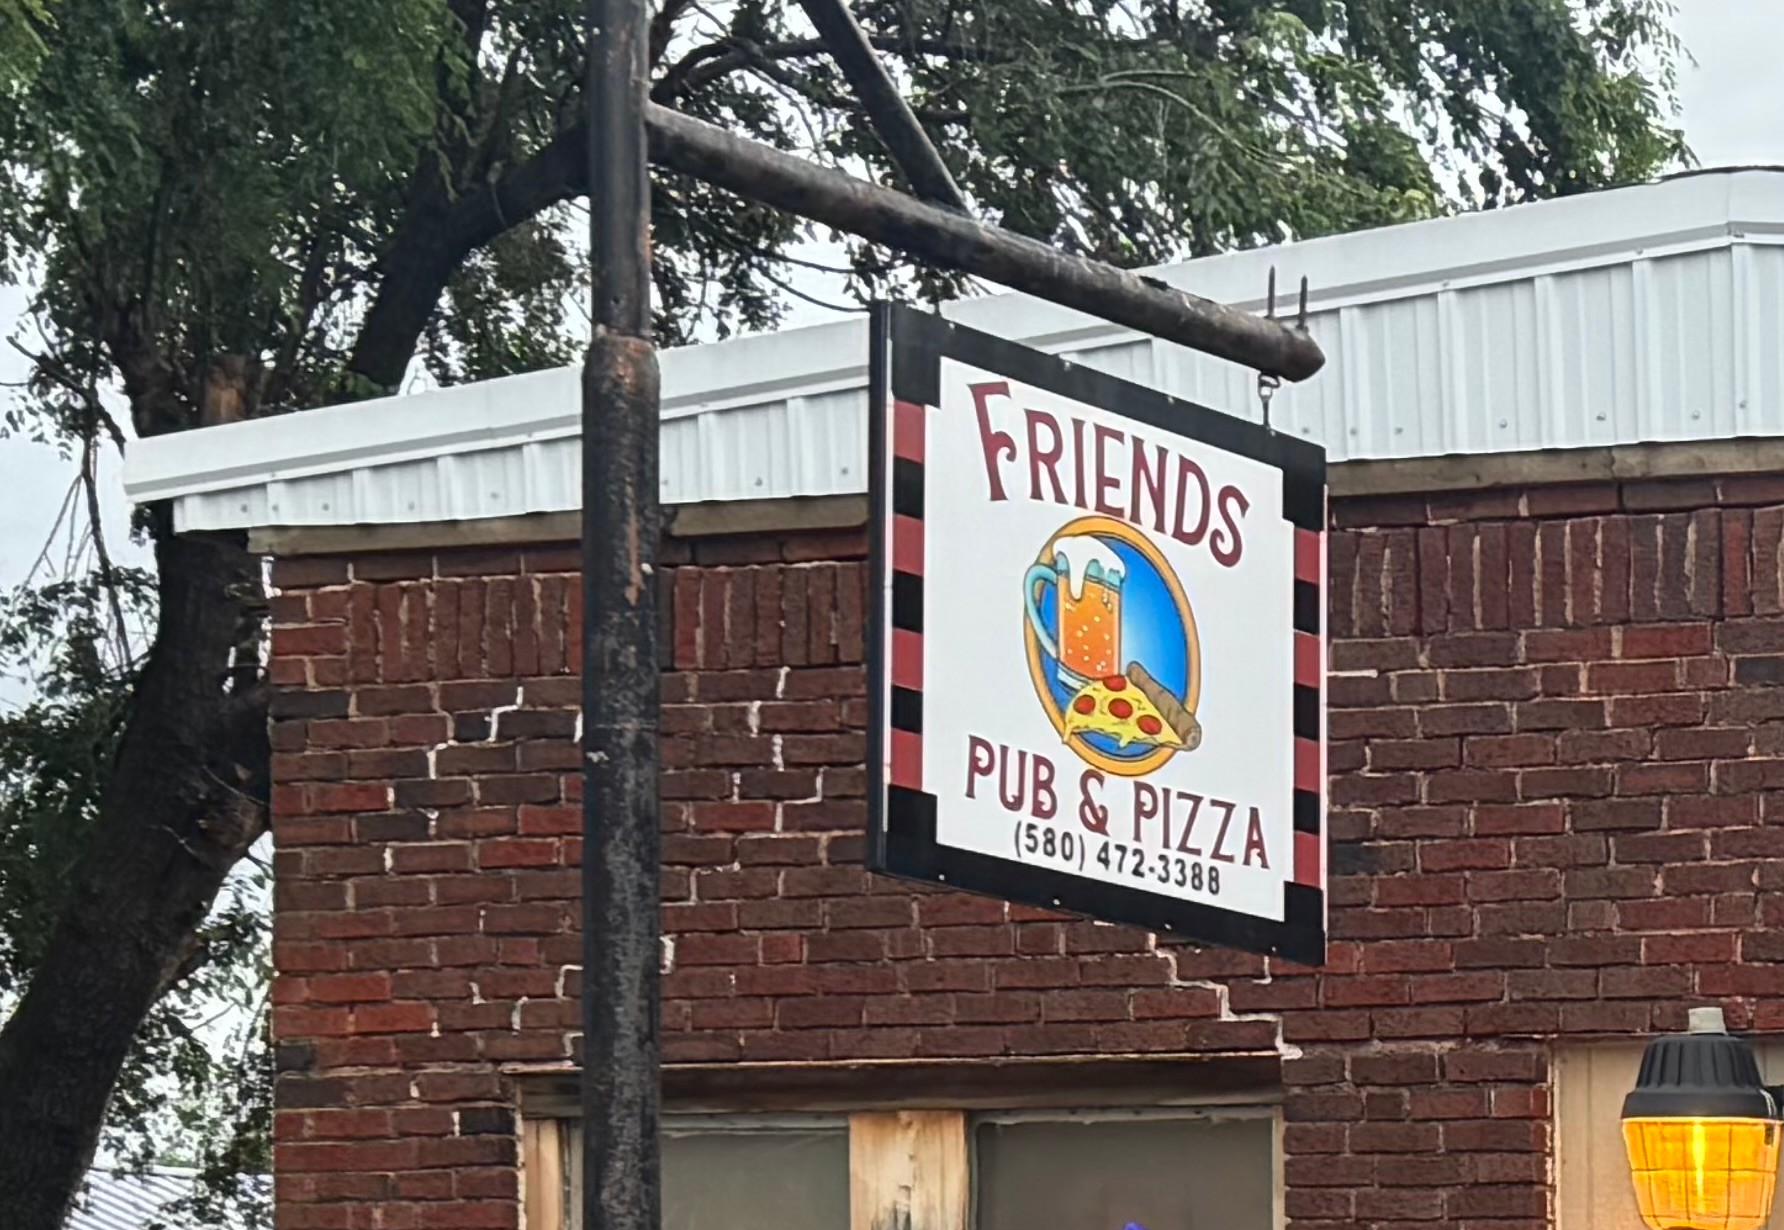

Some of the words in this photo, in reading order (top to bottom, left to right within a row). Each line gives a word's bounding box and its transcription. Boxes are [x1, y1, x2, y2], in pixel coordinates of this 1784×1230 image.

[969, 382, 1249, 567] FRIENDS
[965, 735, 1058, 819] PUB
[1079, 770, 1108, 834] &
[1133, 781, 1269, 869] PIZZA
[1014, 821, 1085, 871] (580)
[1097, 843, 1221, 895] 472-3388
